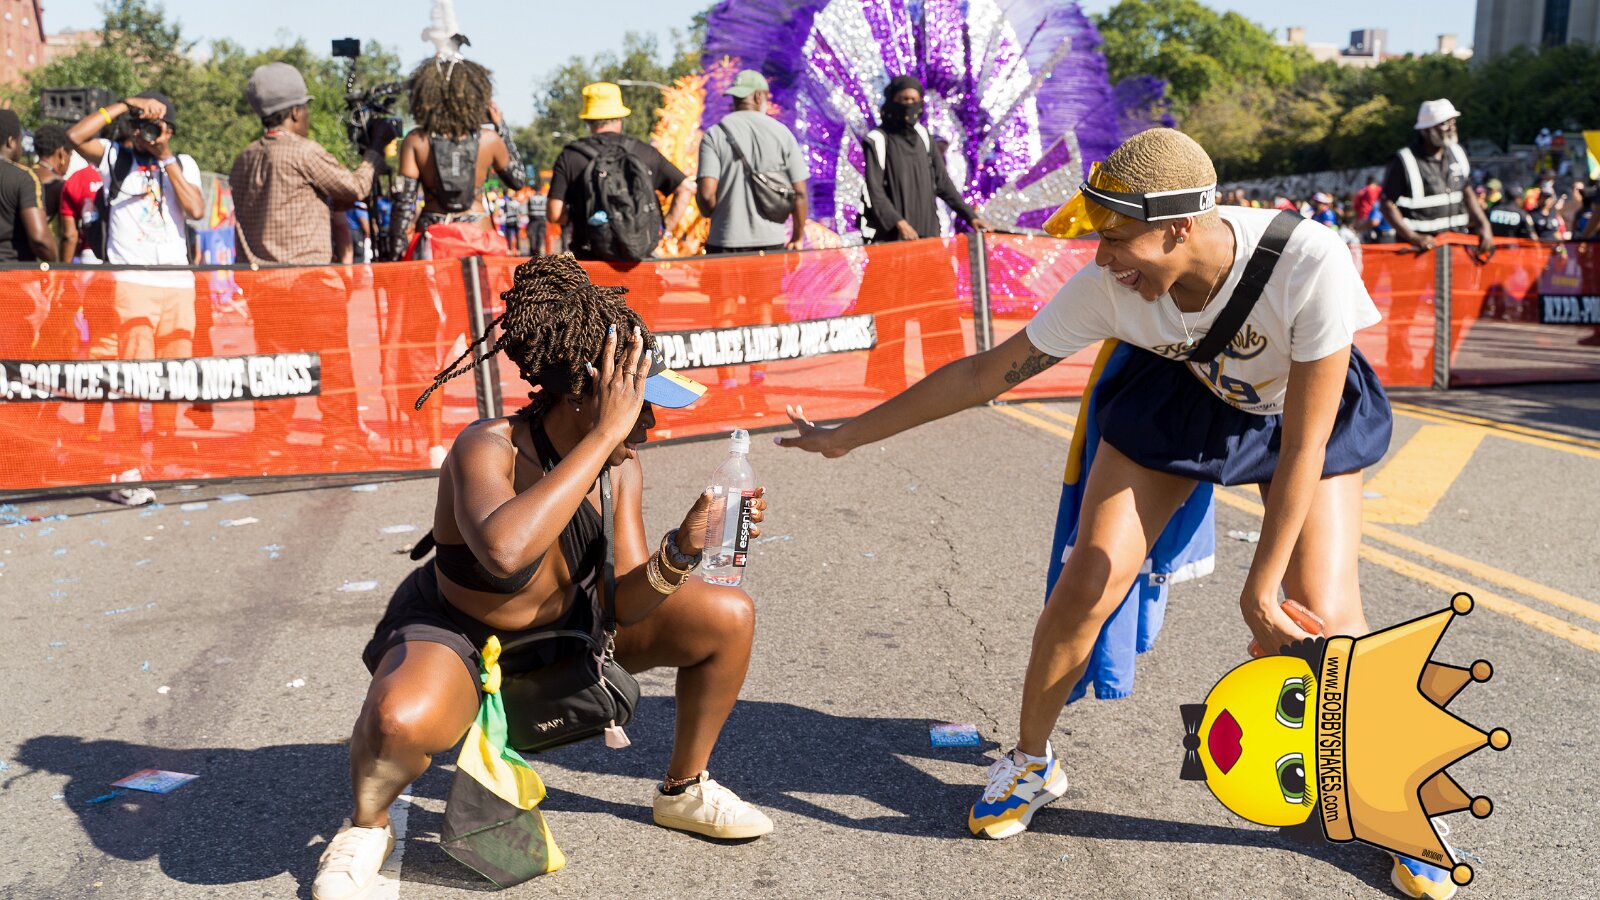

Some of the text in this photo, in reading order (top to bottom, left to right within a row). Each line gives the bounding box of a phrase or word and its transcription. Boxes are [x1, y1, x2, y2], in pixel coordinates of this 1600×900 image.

[743, 328, 779, 362] LINE
[780, 324, 800, 358] DO
[800, 321, 829, 355] NOT
[829, 317, 871, 350] CROSS
[107, 362, 165, 400] LINE
[167, 360, 198, 400] DO
[201, 358, 245, 398] NOT
[248, 354, 311, 397] CROSS
